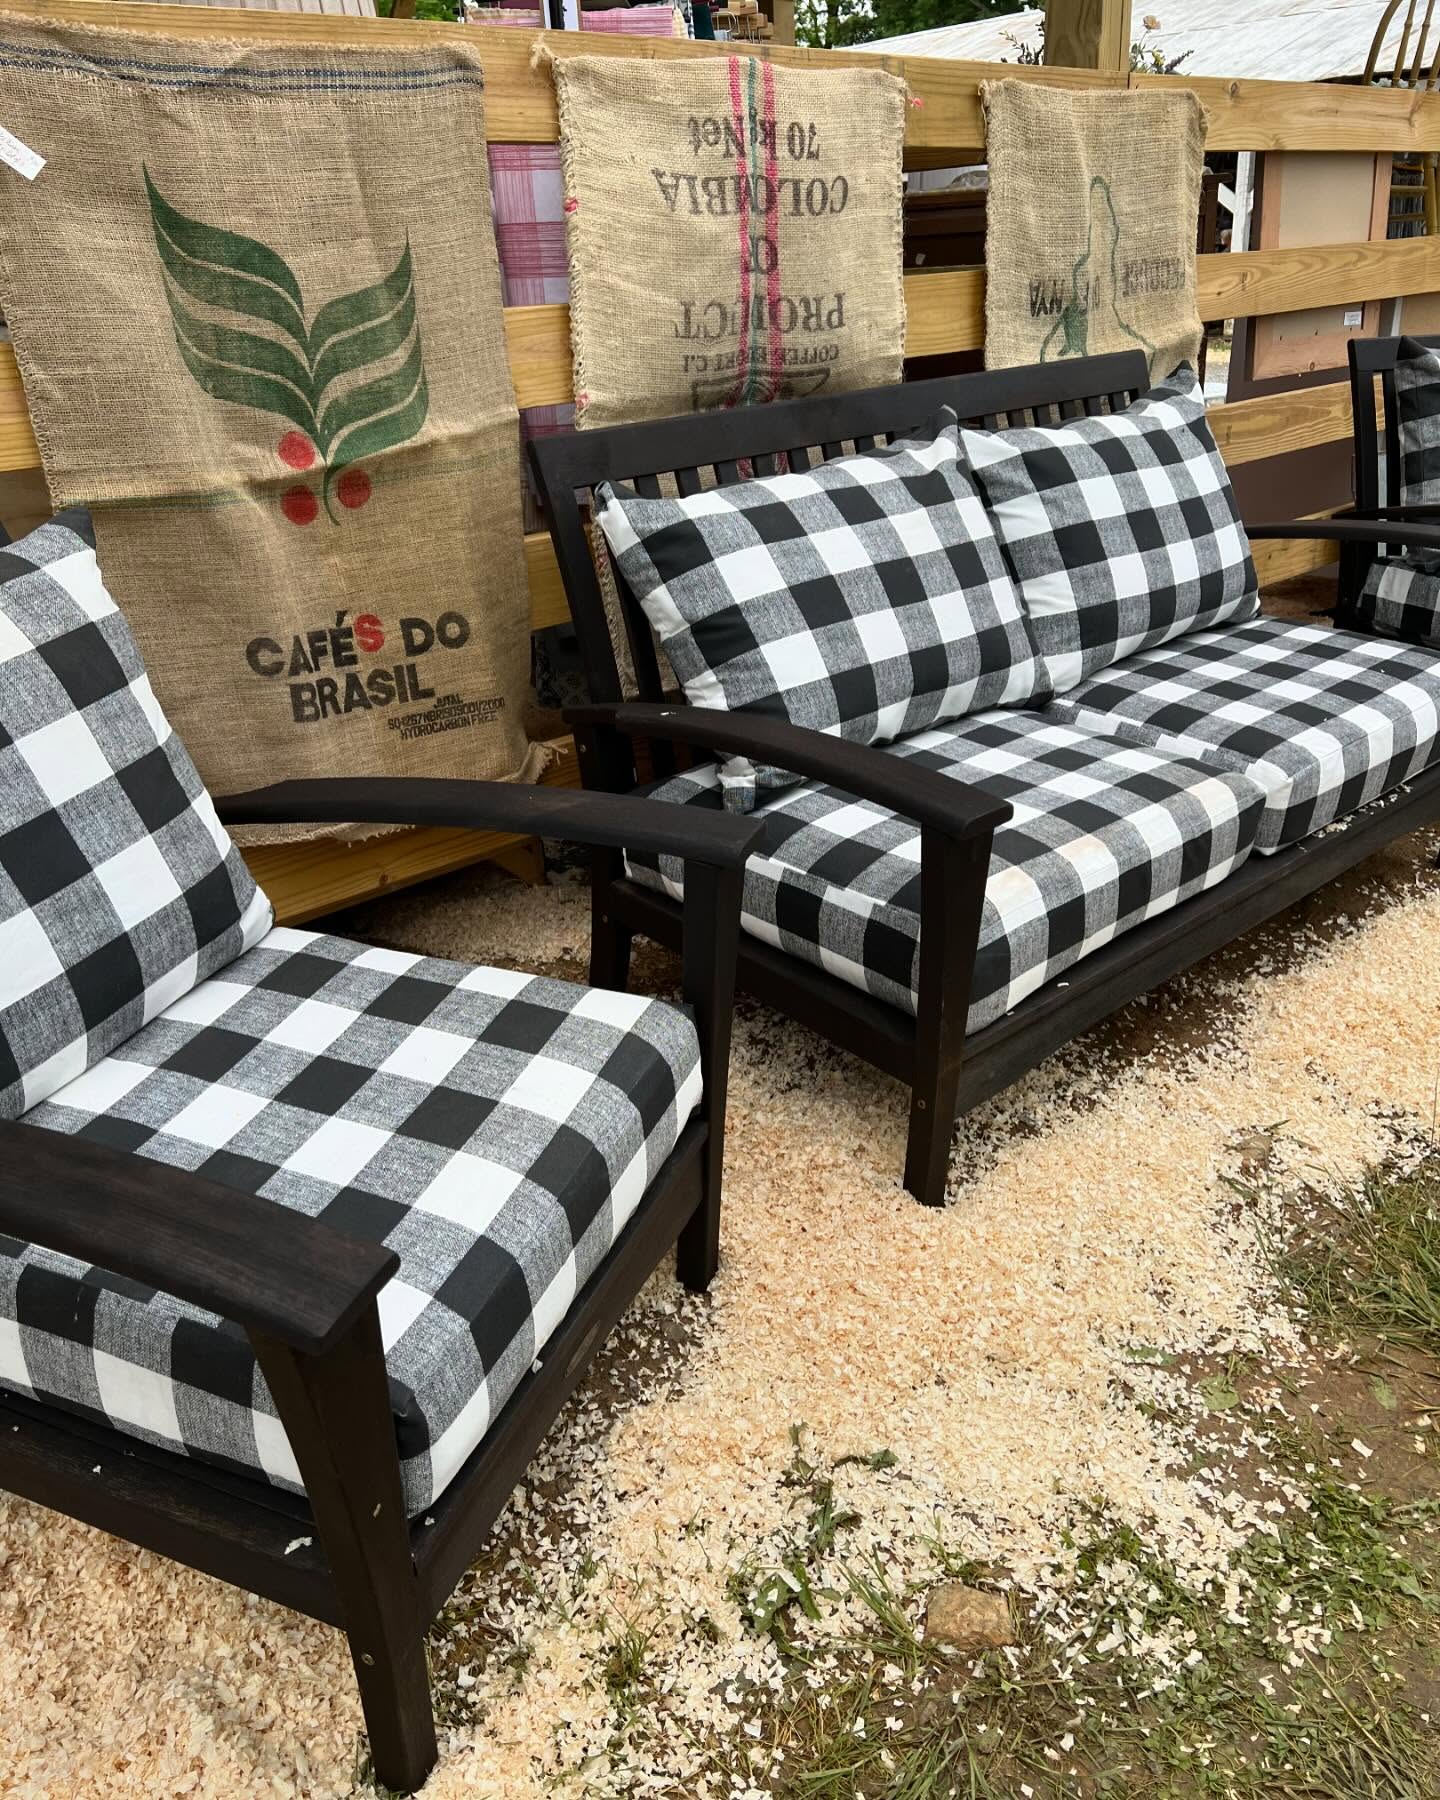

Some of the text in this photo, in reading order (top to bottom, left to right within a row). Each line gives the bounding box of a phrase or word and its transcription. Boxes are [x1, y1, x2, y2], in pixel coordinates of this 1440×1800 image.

[687, 115, 747, 159] Net
[787, 121, 820, 161] 70
[246, 610, 471, 677] CAFÉS DO
[288, 663, 436, 723] BRASIL
